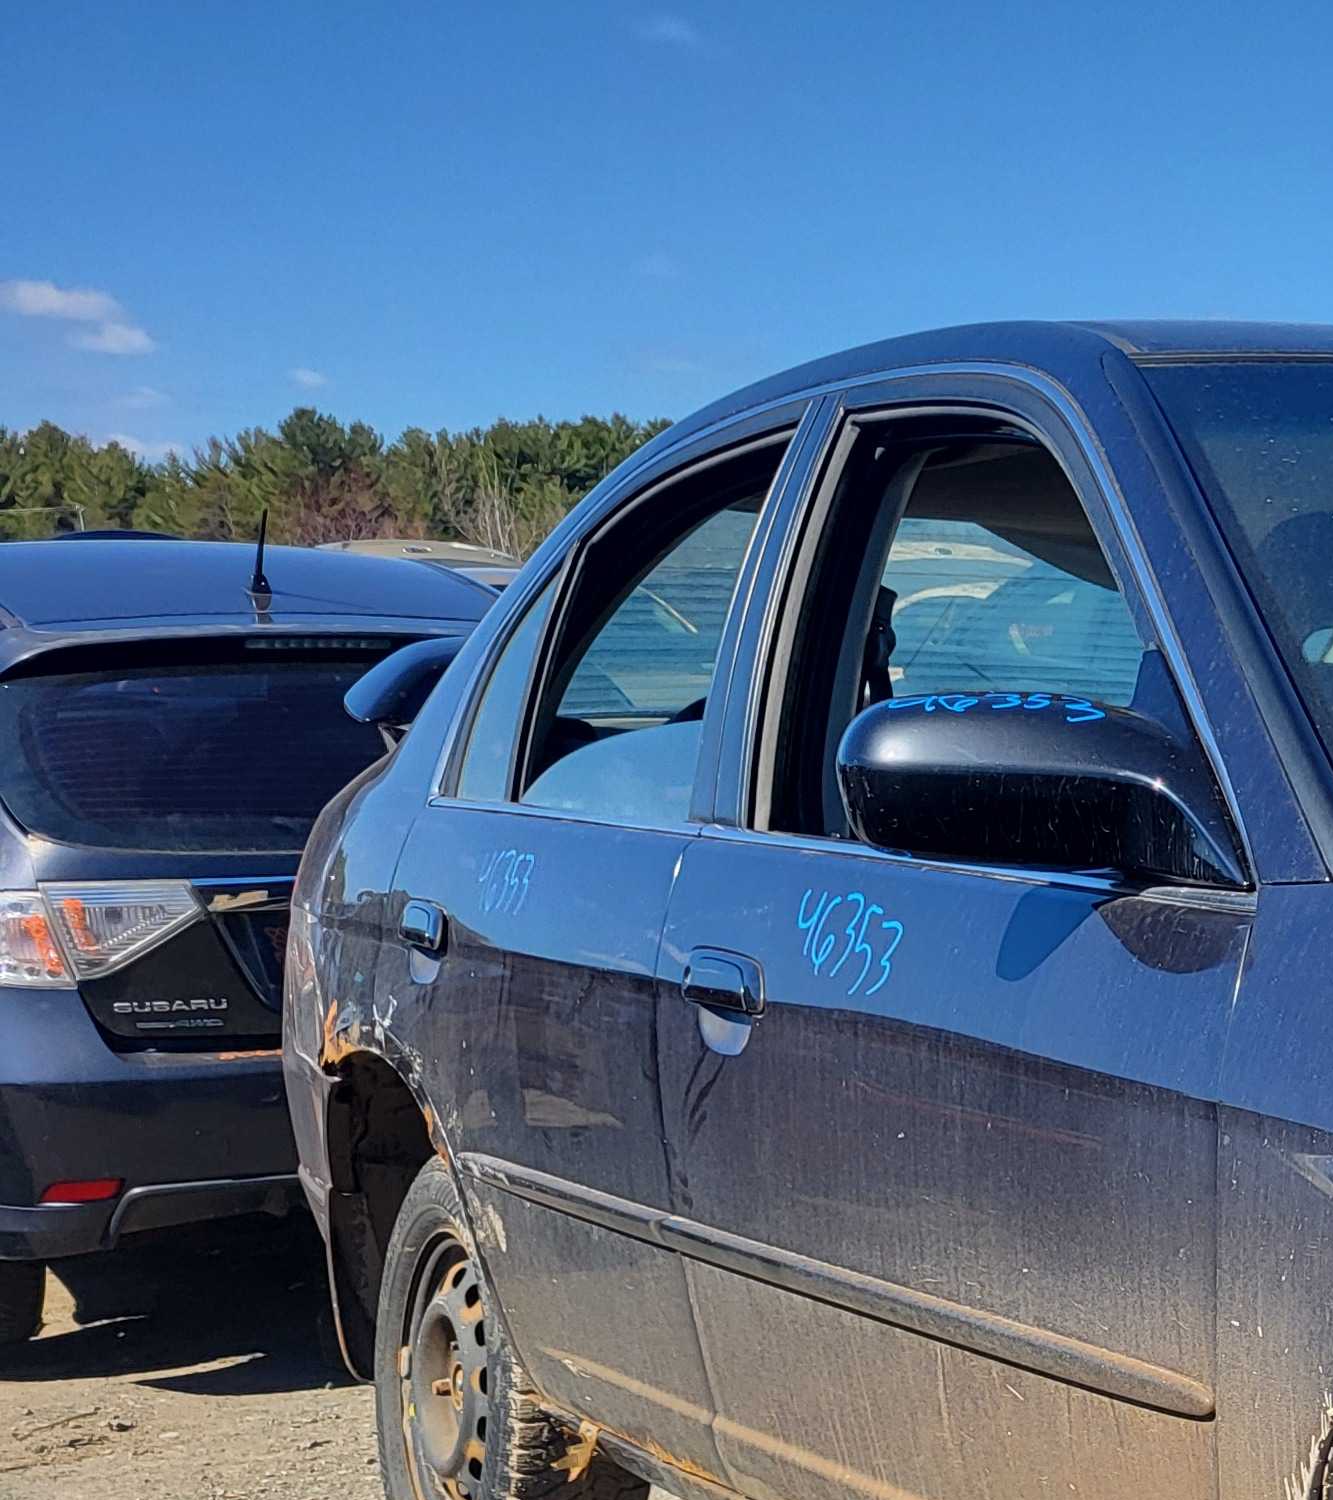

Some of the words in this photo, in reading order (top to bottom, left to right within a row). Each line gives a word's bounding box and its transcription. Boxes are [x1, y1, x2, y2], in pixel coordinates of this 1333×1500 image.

[888, 692, 1106, 722] 46353
[798, 888, 904, 996] 46353
[112, 998, 229, 1014] SUBARU
